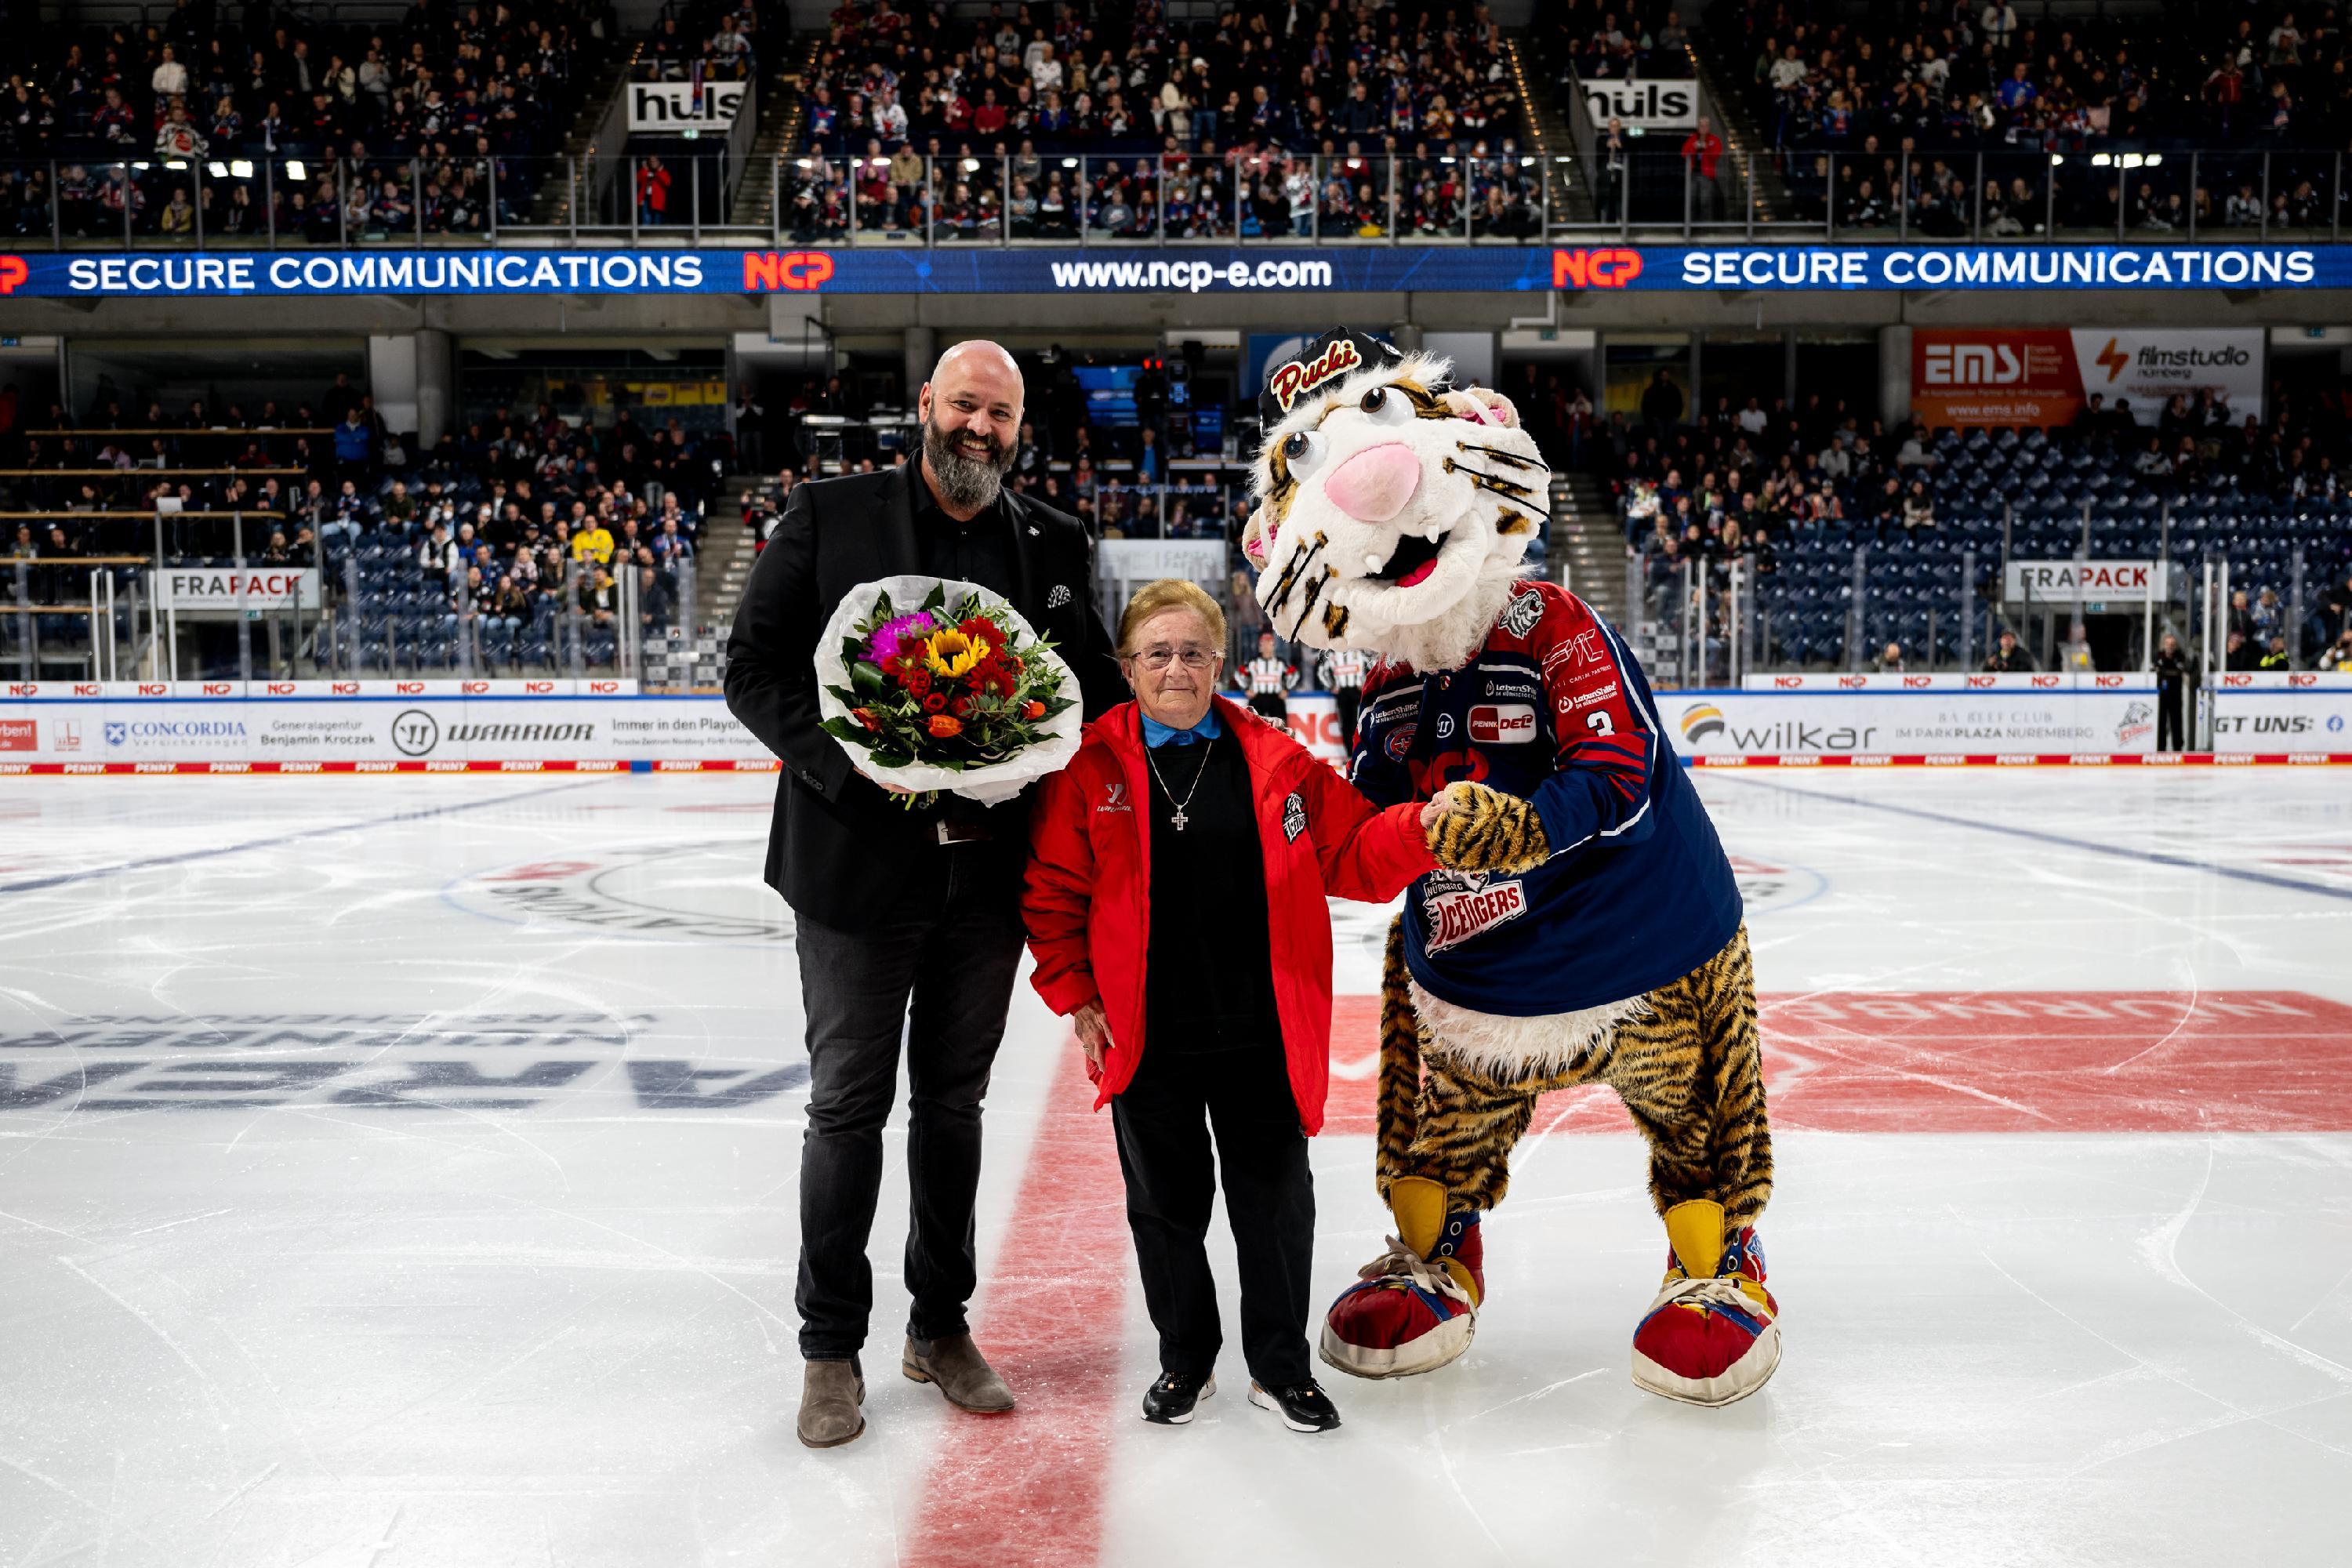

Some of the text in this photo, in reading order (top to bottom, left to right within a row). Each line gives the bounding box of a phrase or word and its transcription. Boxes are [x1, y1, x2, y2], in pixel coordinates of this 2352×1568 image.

[636, 87, 742, 121] hüls
[1583, 85, 1690, 118] hüls
[744, 252, 834, 291] NCP
[1552, 249, 1643, 289] NCP
[1682, 250, 2314, 285] SECURE COMMUNICATIONS
[69, 256, 702, 291] SECURE COMMUNICATIONS
[1051, 260, 1332, 293] www.ncp-e.com
[2137, 345, 2249, 366] filmstudio
[1925, 344, 2020, 384] EMS
[1272, 341, 1361, 410] Pucki
[1946, 401, 2040, 416] www.ems.info
[2020, 568, 2148, 587] FRAPACK
[172, 575, 303, 595] FRAPACK
[1775, 677, 1802, 687] NCP
[1839, 677, 1866, 686] NCP
[1904, 677, 1931, 686] NCP
[1969, 677, 1994, 686] NCP
[2032, 677, 2059, 686] NCP
[2096, 677, 2123, 685] NCP
[2224, 675, 2252, 685] NCP
[2289, 676, 2317, 684] NCP
[9, 685, 38, 695] NCP
[74, 684, 96, 695] NC
[139, 684, 165, 694] NCP
[203, 684, 230, 694] NCP
[268, 684, 295, 694] NCP
[332, 684, 358, 694] NCP
[397, 683, 424, 693] NCP
[462, 682, 488, 692] NCP
[526, 682, 553, 692] NCP
[590, 682, 618, 692] NCP
[1500, 714, 1534, 730] DEL
[2010, 712, 2053, 724] CLUB
[131, 722, 247, 736] CONCORDIA
[272, 720, 363, 731] Generalagentur
[613, 718, 654, 731] Immer
[658, 718, 669, 731] in
[673, 718, 696, 731] den
[2254, 716, 2314, 733] UNS:
[447, 723, 594, 742] WARRIOR
[1731, 722, 1878, 750] wilkar
[1896, 728, 1911, 739] IM
[2006, 728, 2094, 739] NUREMBERG
[134, 739, 249, 747] Versicherungen
[261, 735, 376, 746] Benjamin Kroczek
[1705, 756, 1745, 766] PENNY
[1779, 756, 1820, 765] PENNY
[1851, 756, 1891, 765] PENNY
[1925, 755, 1963, 765] PENNY
[1996, 755, 2036, 764] PENNY
[2071, 755, 2110, 764] PENNY
[2142, 754, 2182, 764] PENNY
[2214, 754, 2254, 764] PENNY
[2287, 754, 2328, 764] PENNY
[64, 764, 104, 774] PENNY
[135, 764, 176, 773] PENNY
[209, 764, 250, 773] PENNY
[281, 763, 321, 772] PENNY
[355, 763, 396, 771] PENNY
[426, 762, 467, 771] PENNY
[501, 761, 542, 771] PENNY
[576, 761, 617, 771] PENNY
[660, 760, 701, 770] PENNY
[735, 760, 775, 770] PENNY
[1426, 881, 1464, 897] NÜRNBERG
[1434, 887, 1520, 946] ICETIGERS
